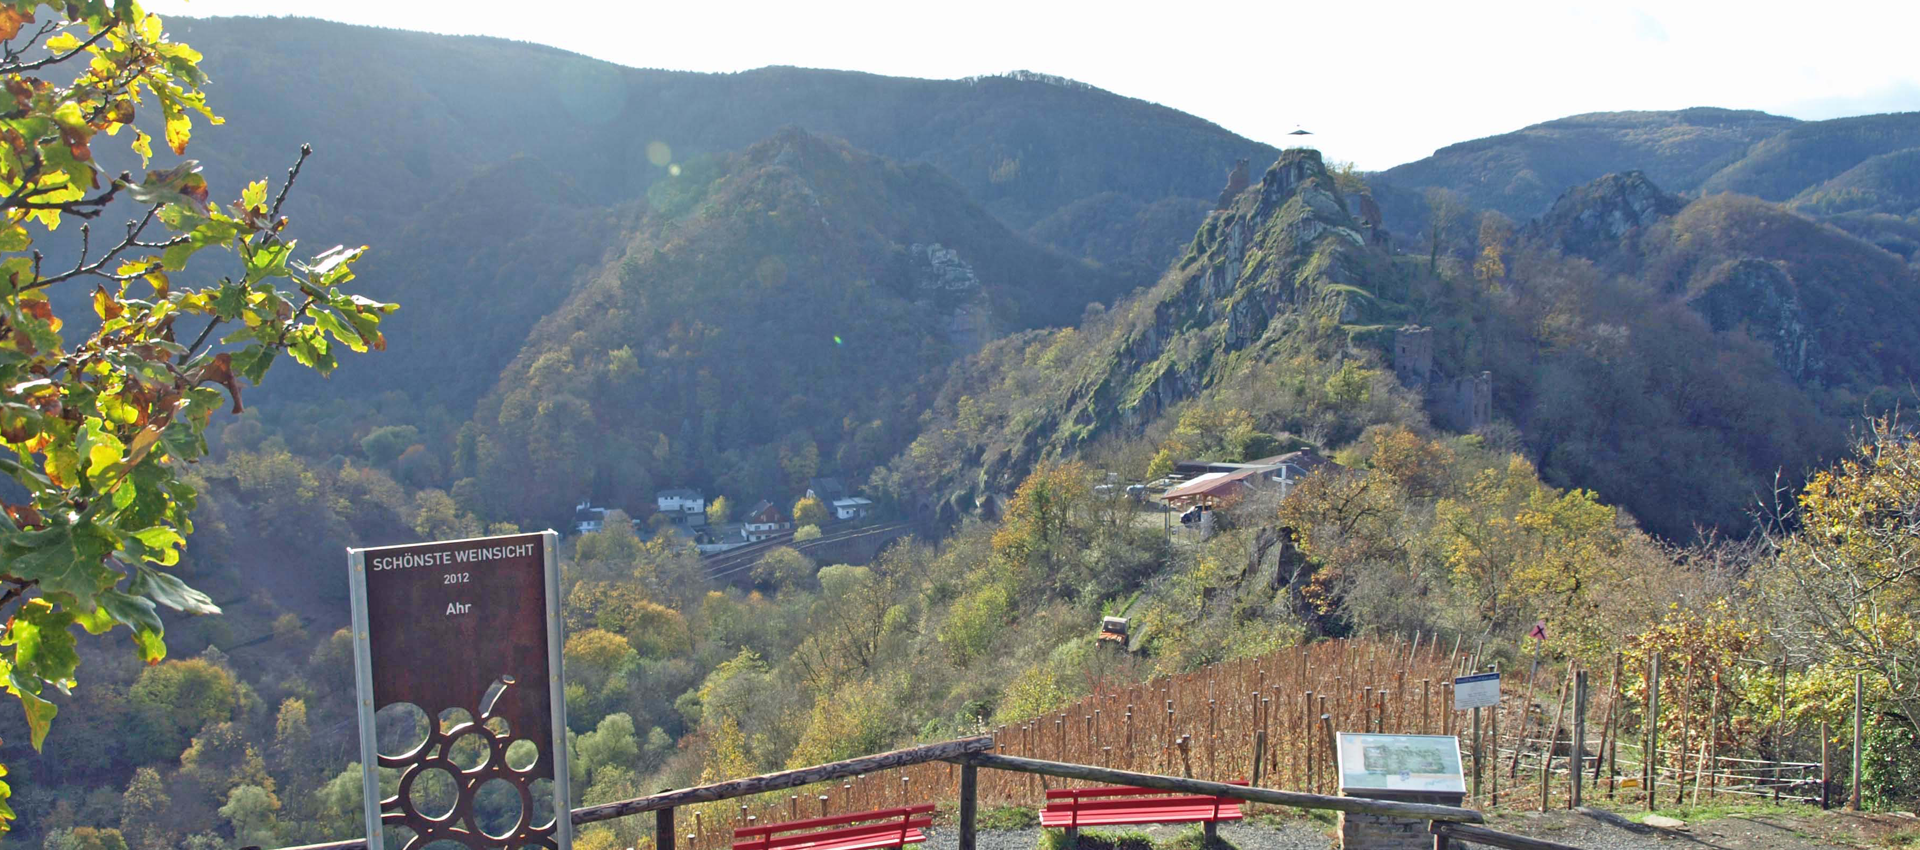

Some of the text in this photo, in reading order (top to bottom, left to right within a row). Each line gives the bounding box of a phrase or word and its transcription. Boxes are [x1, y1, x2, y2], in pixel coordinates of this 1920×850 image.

[373, 543, 535, 571] SCHÖNSTE WEINSICHT
[443, 572, 470, 585] 2012
[445, 602, 472, 616] Ahr
